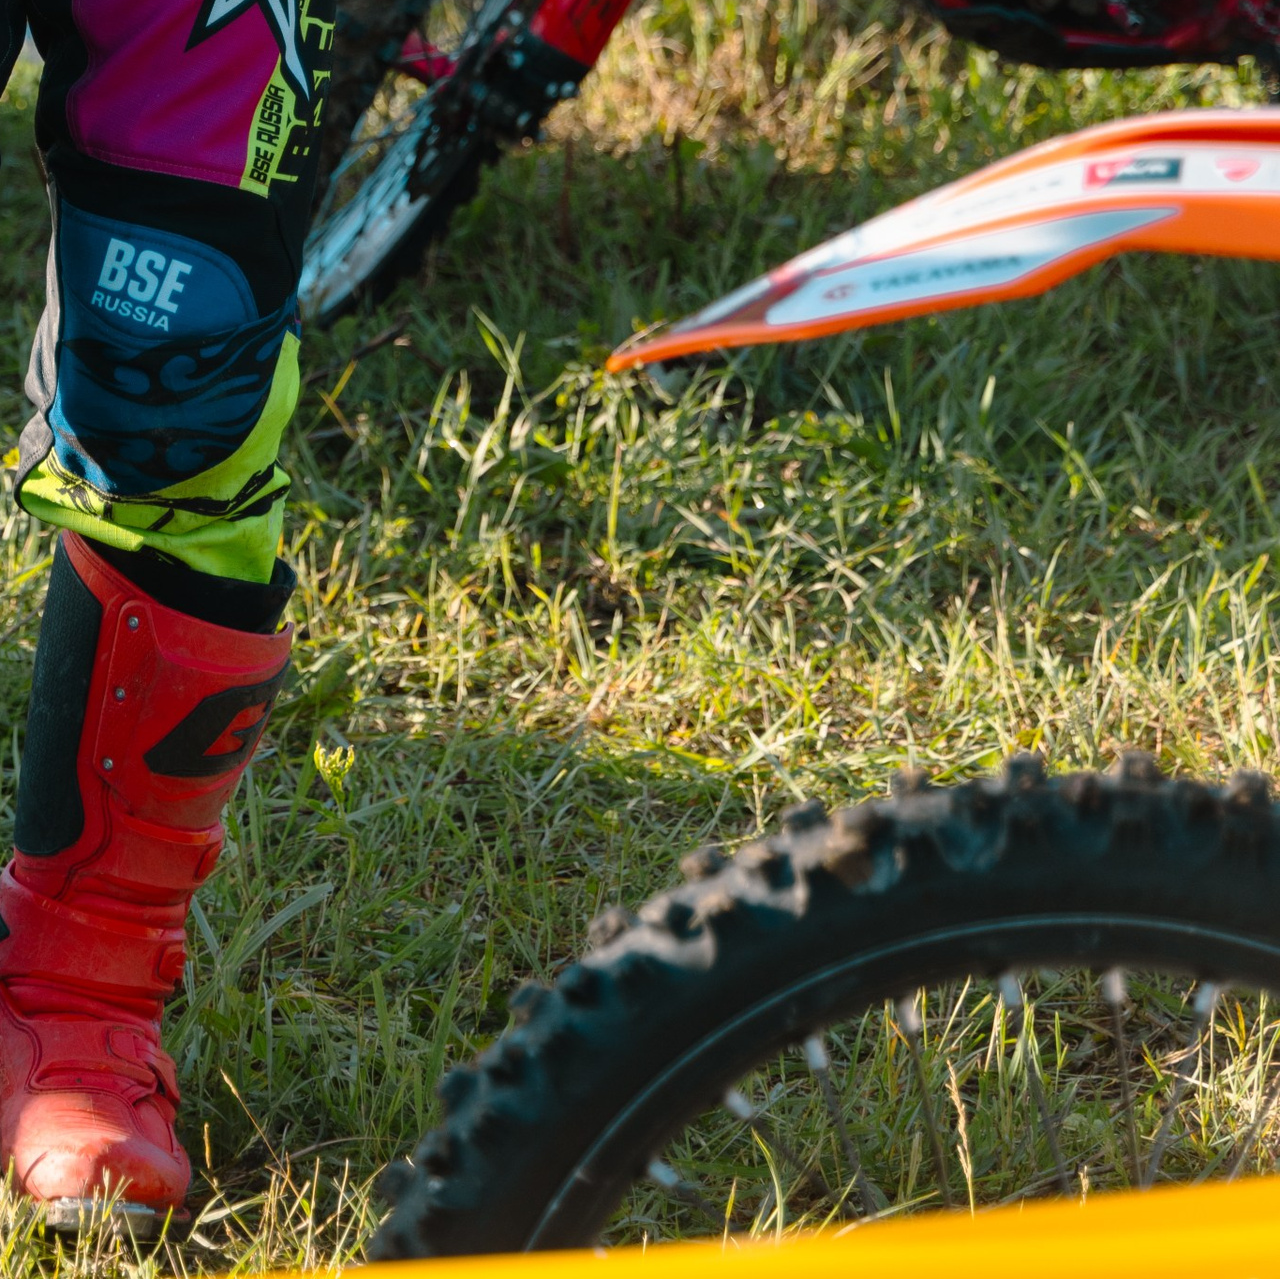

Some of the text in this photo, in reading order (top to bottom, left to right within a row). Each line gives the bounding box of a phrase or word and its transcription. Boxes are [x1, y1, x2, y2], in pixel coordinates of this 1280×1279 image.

[248, 84, 287, 183] BSE RUSSIA
[91, 289, 172, 333] RUSSIA
[97, 237, 193, 315] BSE
